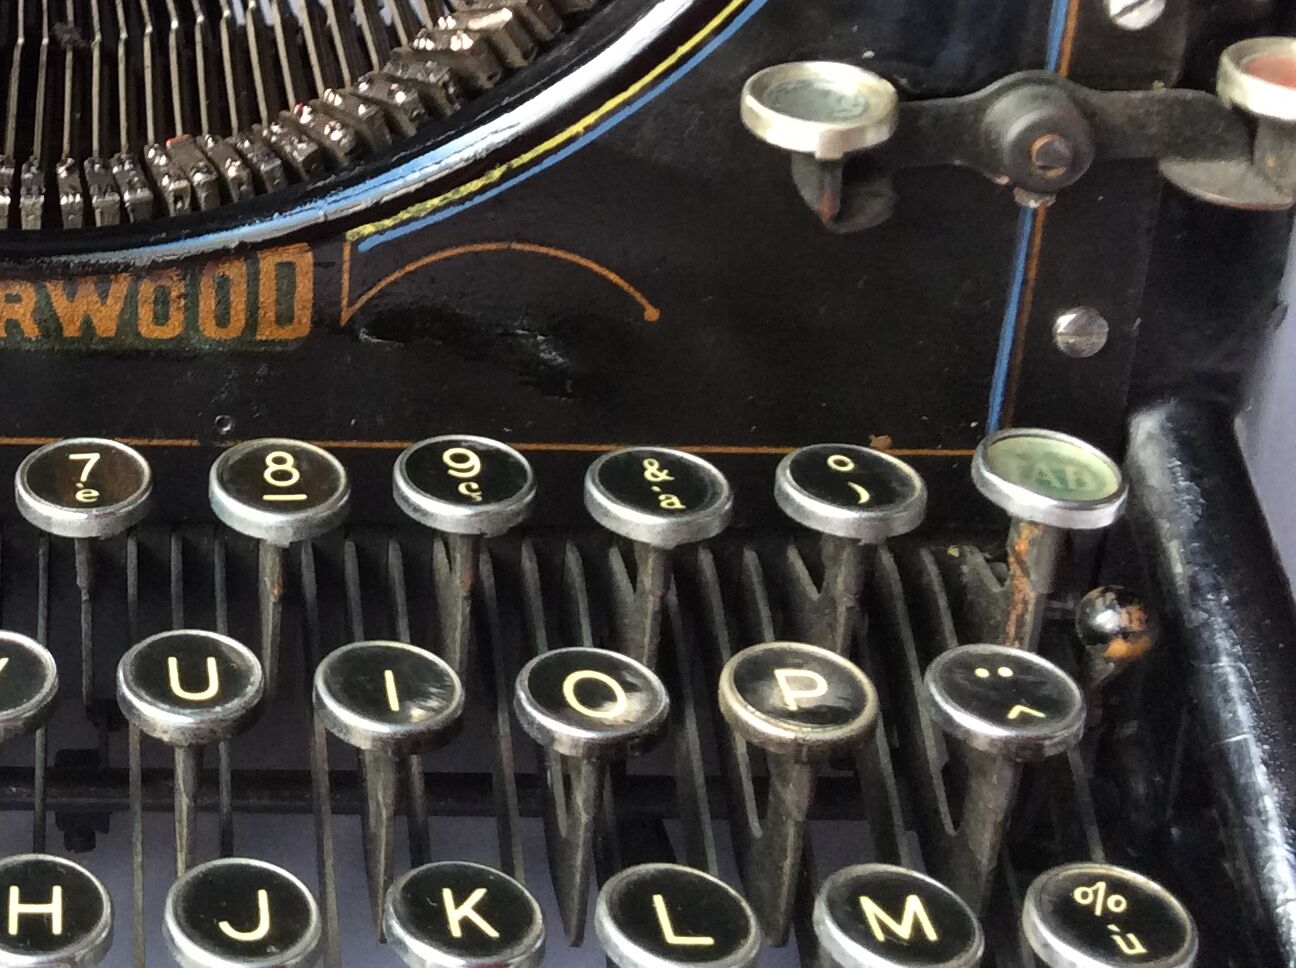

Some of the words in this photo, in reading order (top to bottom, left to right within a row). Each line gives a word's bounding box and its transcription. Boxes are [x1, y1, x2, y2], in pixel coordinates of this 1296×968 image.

[68, 452, 101, 482] 7
[263, 450, 300, 487] 8
[442, 447, 481, 478] 9
[643, 458, 674, 482] &
[167, 656, 220, 701] U
[384, 669, 400, 712] I
[562, 669, 628, 719] O
[774, 667, 829, 711] P
[8, 885, 63, 936] H
[218, 889, 270, 942] J
[442, 887, 500, 938] K
[652, 894, 715, 946] L
[859, 894, 940, 944] M
